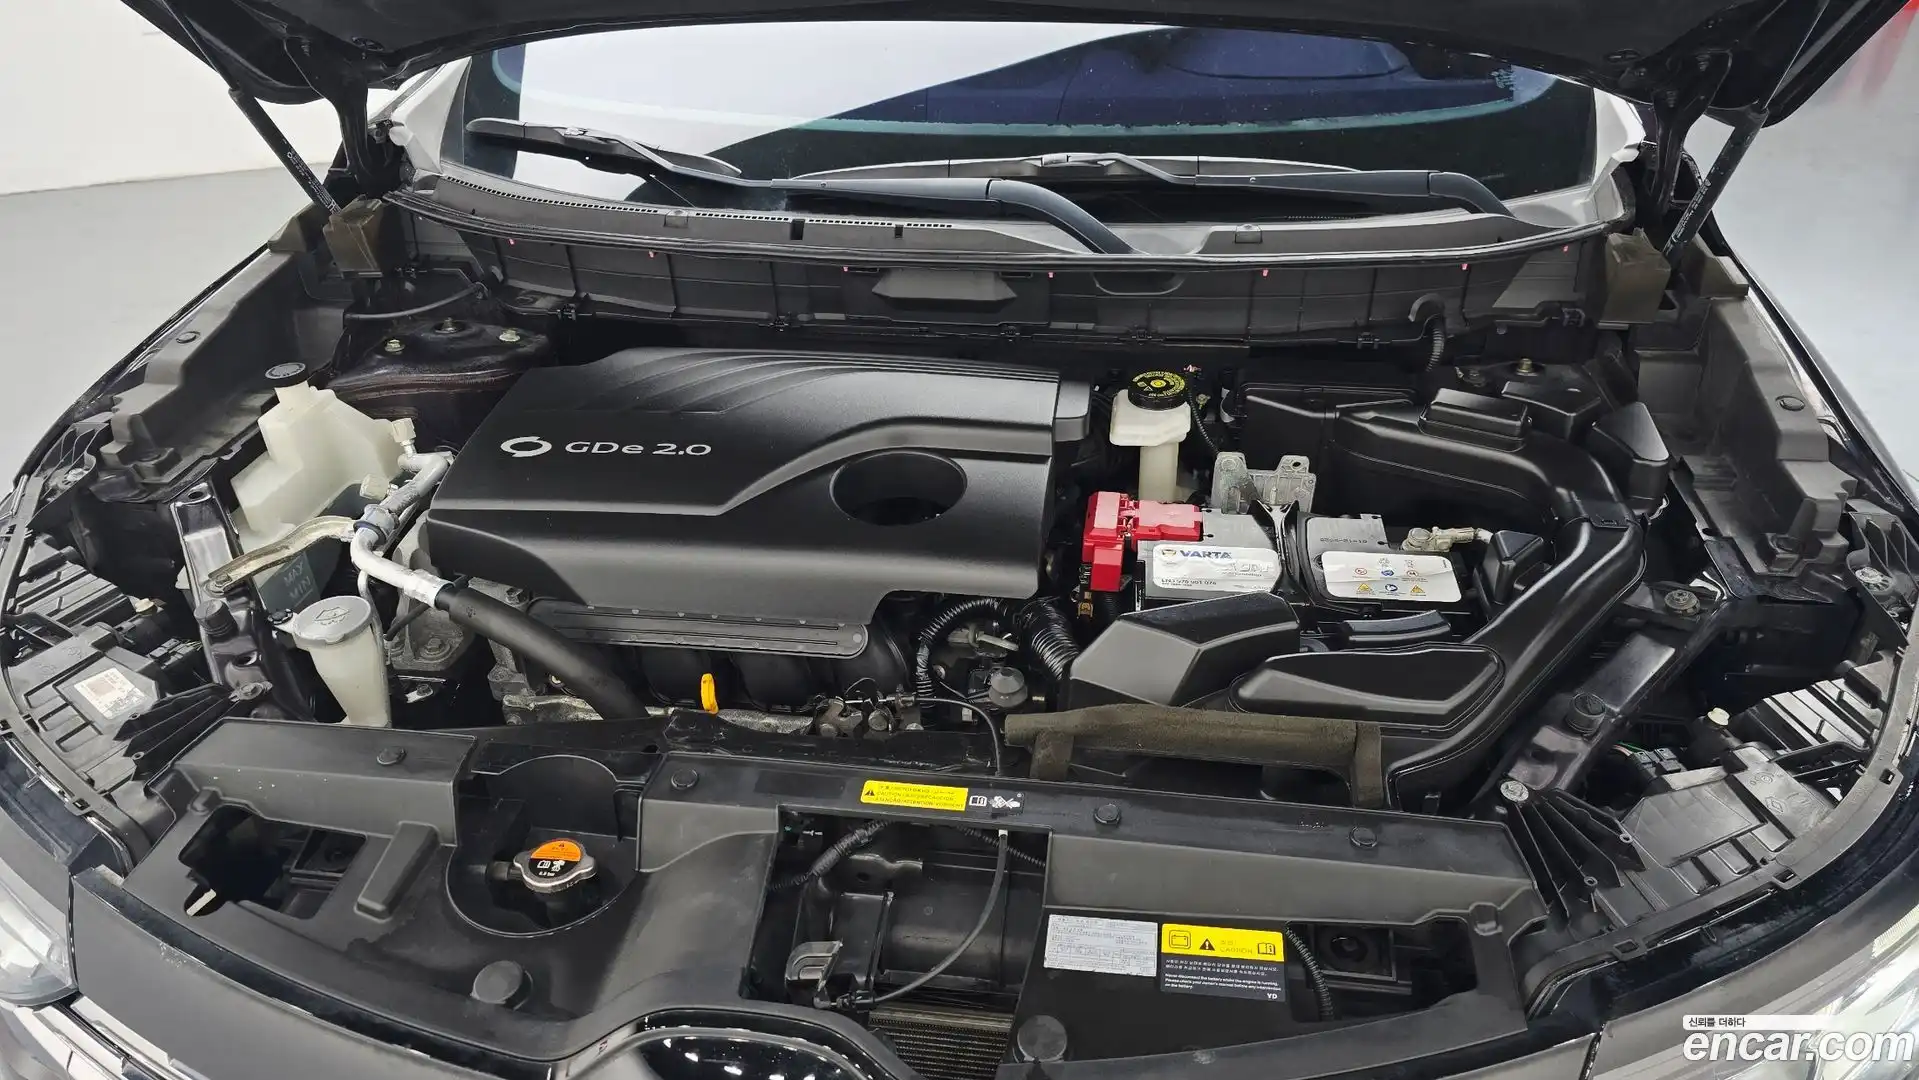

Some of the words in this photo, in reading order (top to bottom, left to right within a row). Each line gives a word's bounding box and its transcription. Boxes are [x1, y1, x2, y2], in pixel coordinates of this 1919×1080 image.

[565, 441, 645, 454] GDe
[652, 443, 712, 456] 2.0
[1180, 550, 1232, 559] VARTA
